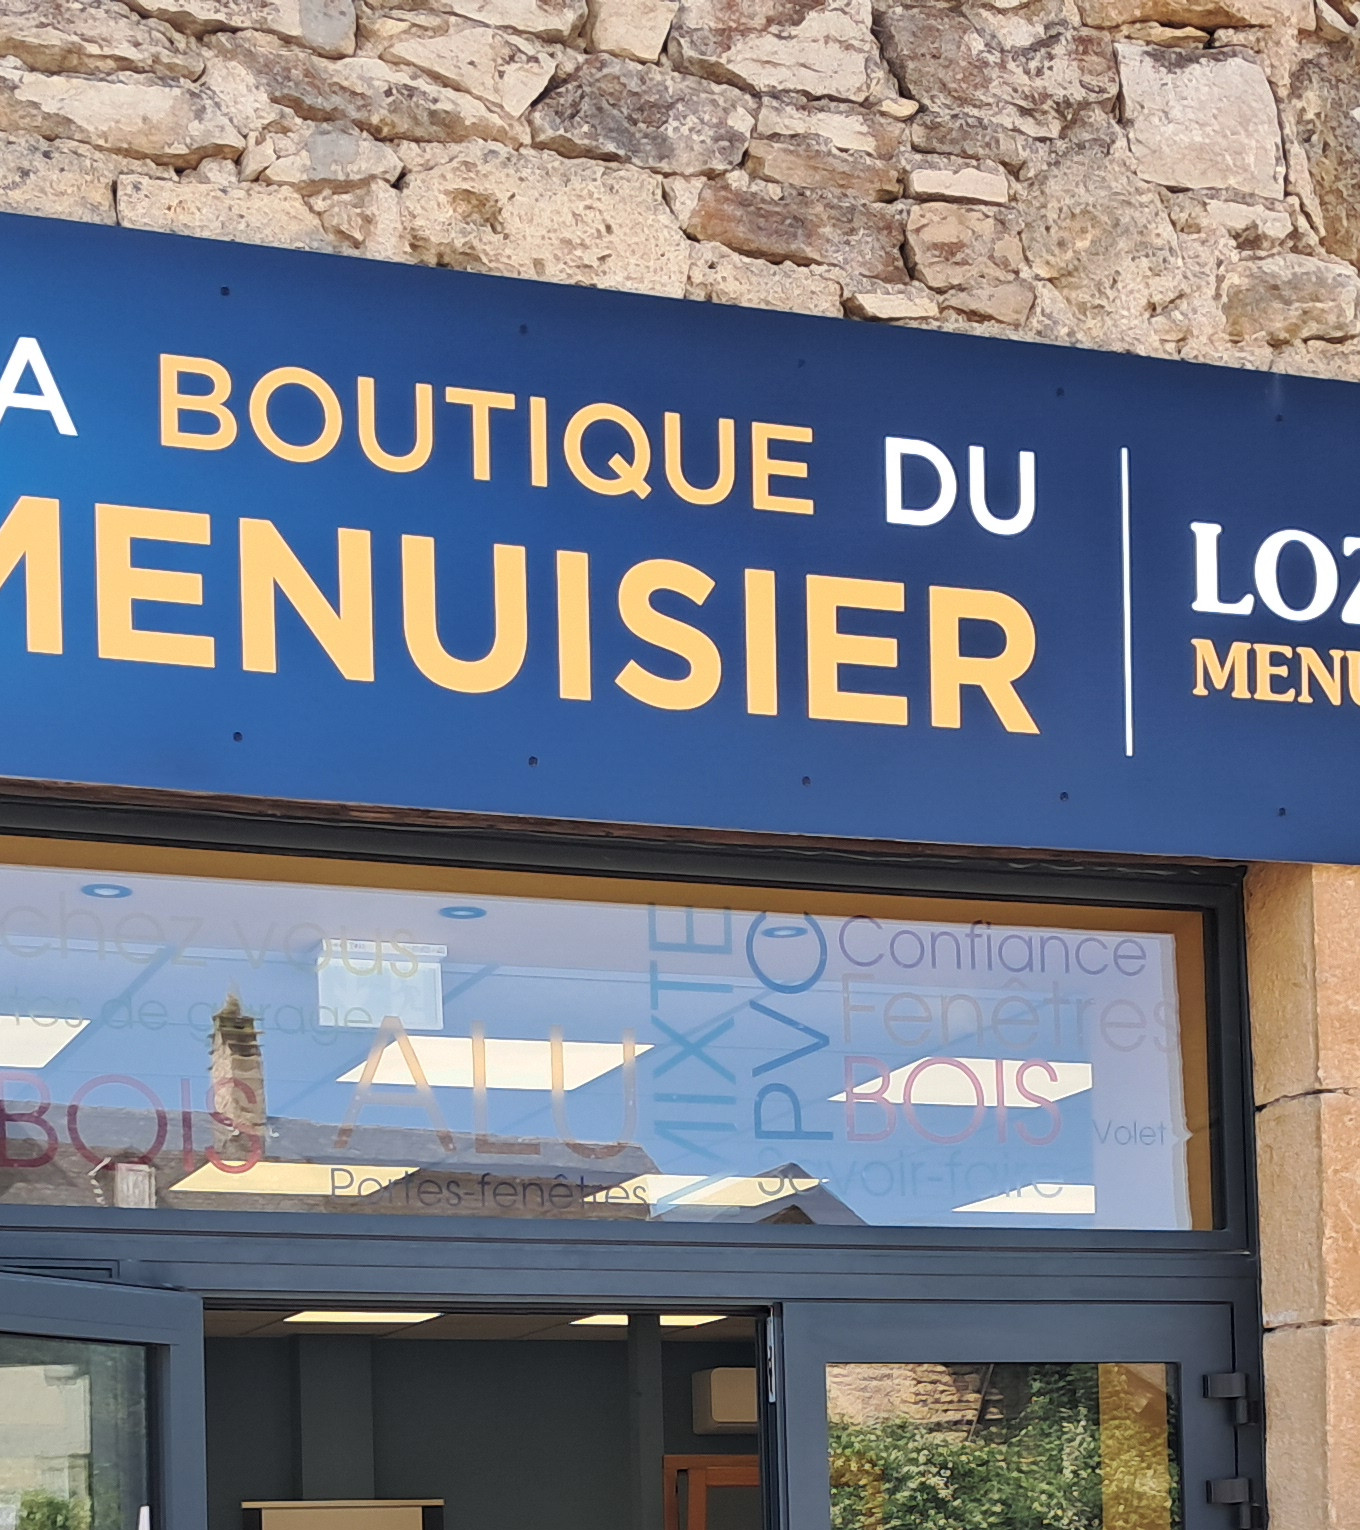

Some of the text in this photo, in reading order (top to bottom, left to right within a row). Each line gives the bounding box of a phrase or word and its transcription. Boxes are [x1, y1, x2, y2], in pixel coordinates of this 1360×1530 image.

[159, 353, 816, 517] BOUTIQUE
[885, 435, 1038, 537] DU
[838, 915, 1148, 977] Confiance
[188, 998, 373, 1046] grage
[746, 911, 834, 1141] PVC
[840, 973, 1179, 1053] Fenêtres
[333, 1015, 638, 1160] ALU
[844, 1056, 1062, 1146] BOIS
[1092, 1119, 1168, 1146] Volet
[330, 1166, 650, 1210] Portes-fenêtres
